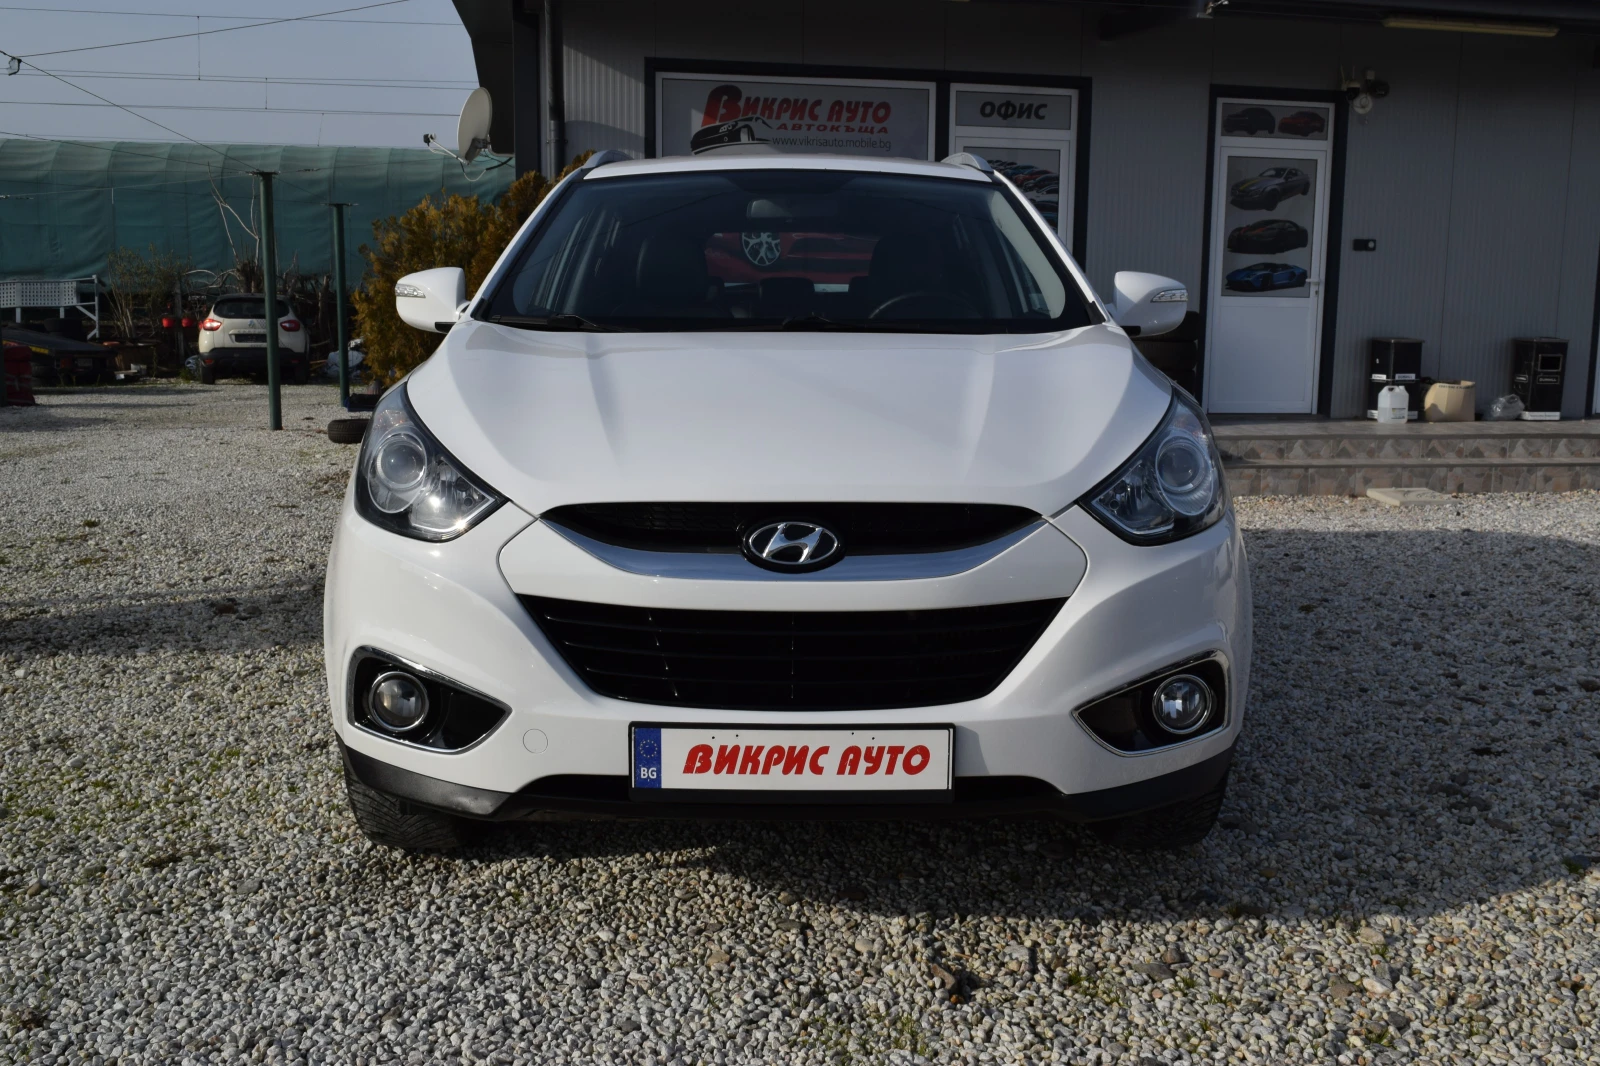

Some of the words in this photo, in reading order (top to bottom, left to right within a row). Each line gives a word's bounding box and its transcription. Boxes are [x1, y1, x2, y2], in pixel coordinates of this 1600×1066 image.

[827, 100, 891, 124] АУТО
[980, 101, 1047, 120] ОФИС
[776, 123, 889, 134] АВТОКЪЩА
[772, 136, 891, 152] www.vikrisauto.mobile.bg
[682, 744, 830, 775] ВИКРИС
[836, 745, 931, 776] АУТО
[640, 766, 657, 779] BG
